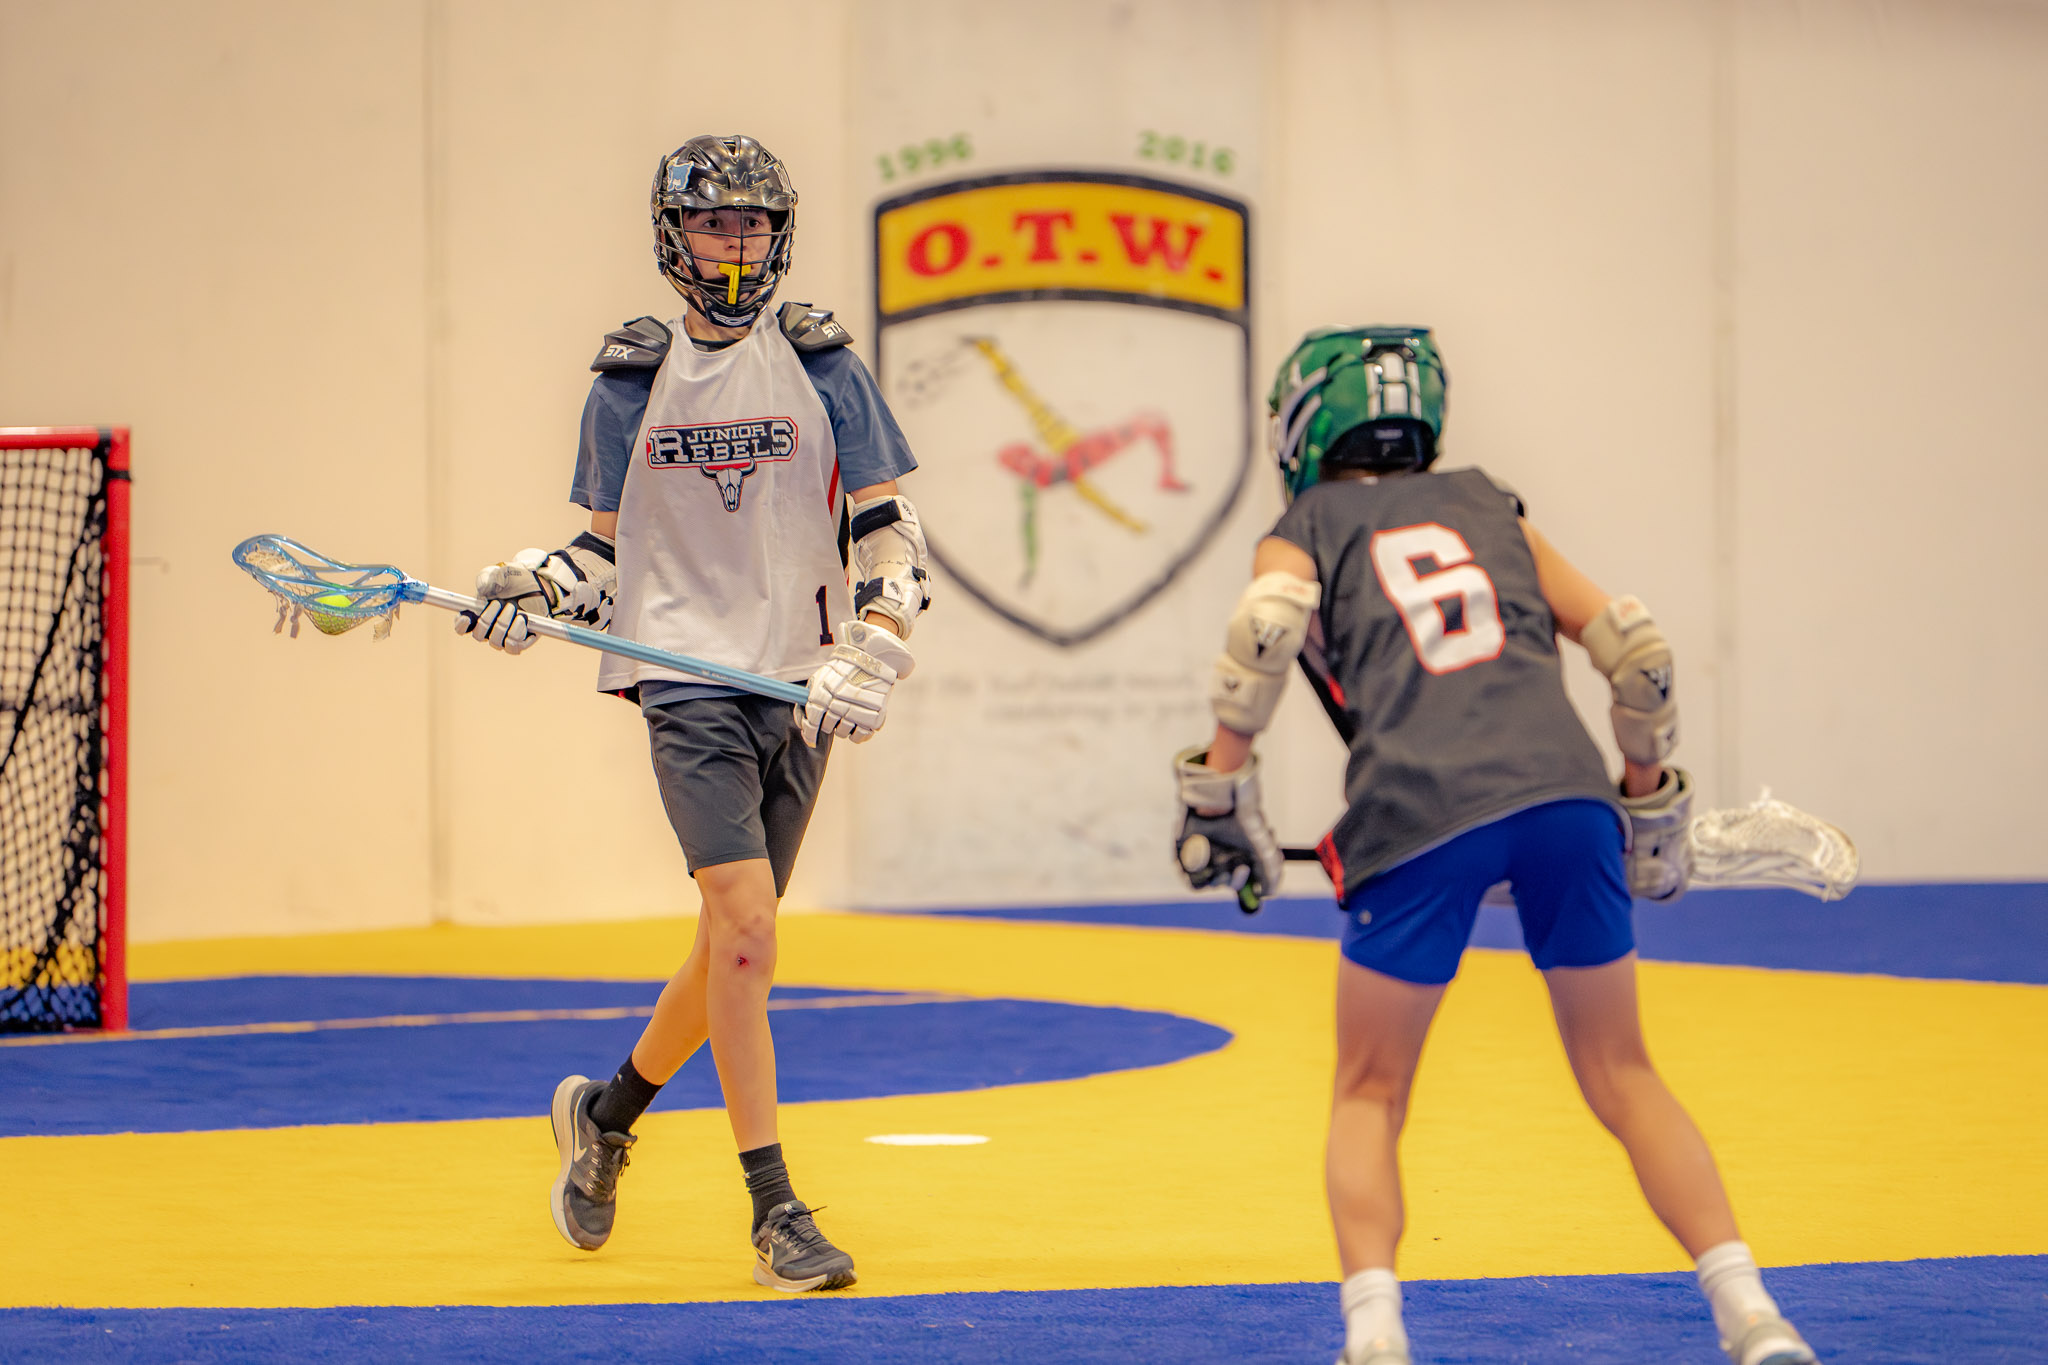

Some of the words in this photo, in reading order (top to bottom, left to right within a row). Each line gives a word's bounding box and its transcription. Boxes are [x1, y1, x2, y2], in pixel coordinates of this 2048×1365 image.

[1137, 130, 1237, 176] 2016
[820, 320, 845, 339] STX
[603, 344, 635, 360] STX
[651, 421, 793, 463] REBELS
[687, 424, 767, 443] JUNIOR
[815, 585, 834, 646] 1
[1370, 522, 1505, 675] 6
